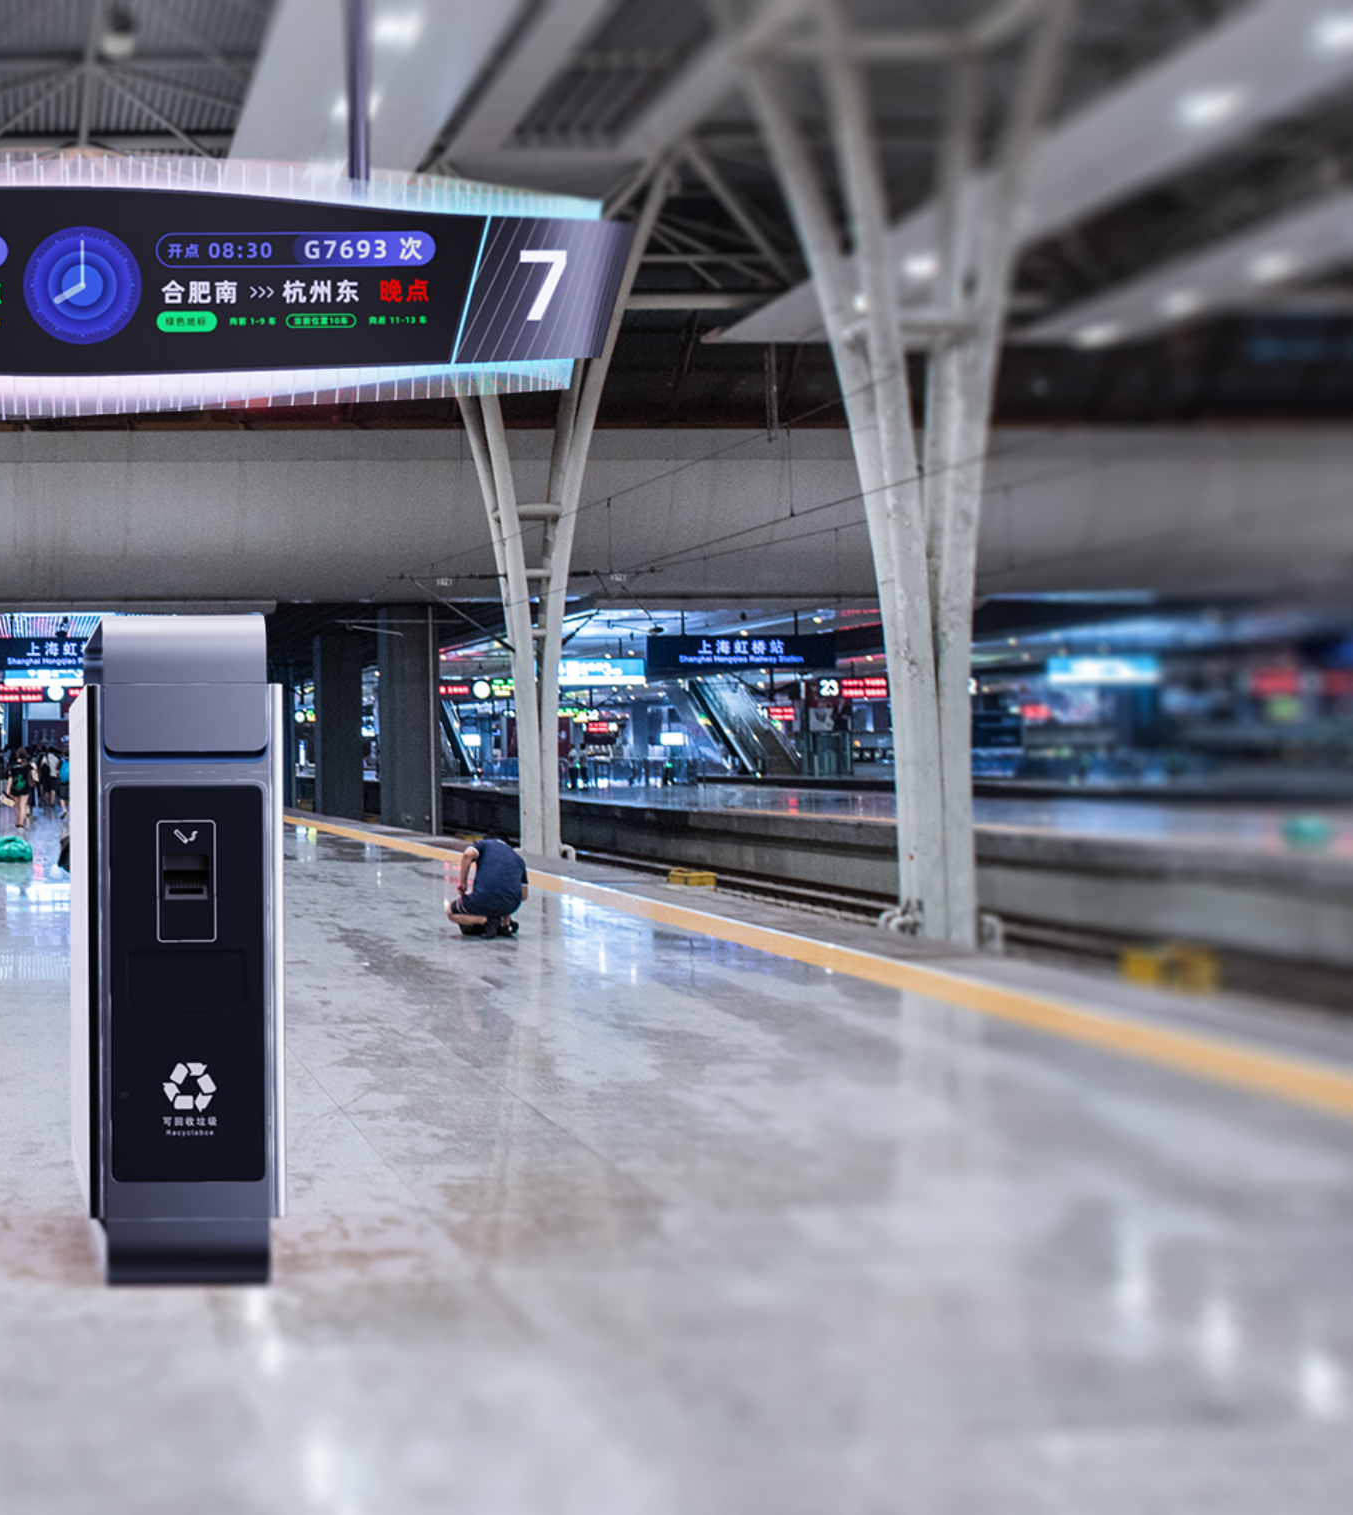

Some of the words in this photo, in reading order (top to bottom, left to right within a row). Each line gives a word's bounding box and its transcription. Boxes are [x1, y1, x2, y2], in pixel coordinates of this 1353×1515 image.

[167, 242, 200, 259] 开点
[207, 241, 273, 260] 08:30
[303, 239, 388, 260] G7693
[399, 237, 422, 261] 次
[161, 279, 238, 304] 合肥南
[282, 279, 360, 304] 杭州东
[379, 278, 430, 302] 晚点
[520, 250, 568, 321] 7
[165, 316, 207, 327] 绿色地标
[250, 317, 266, 326] 1-9
[389, 315, 416, 325] 11-13
[697, 639, 785, 655] 上海虹桥站
[678, 655, 713, 664] Shanghai
[818, 678, 840, 697] 23
[161, 1115, 218, 1127] 可回收垃圾
